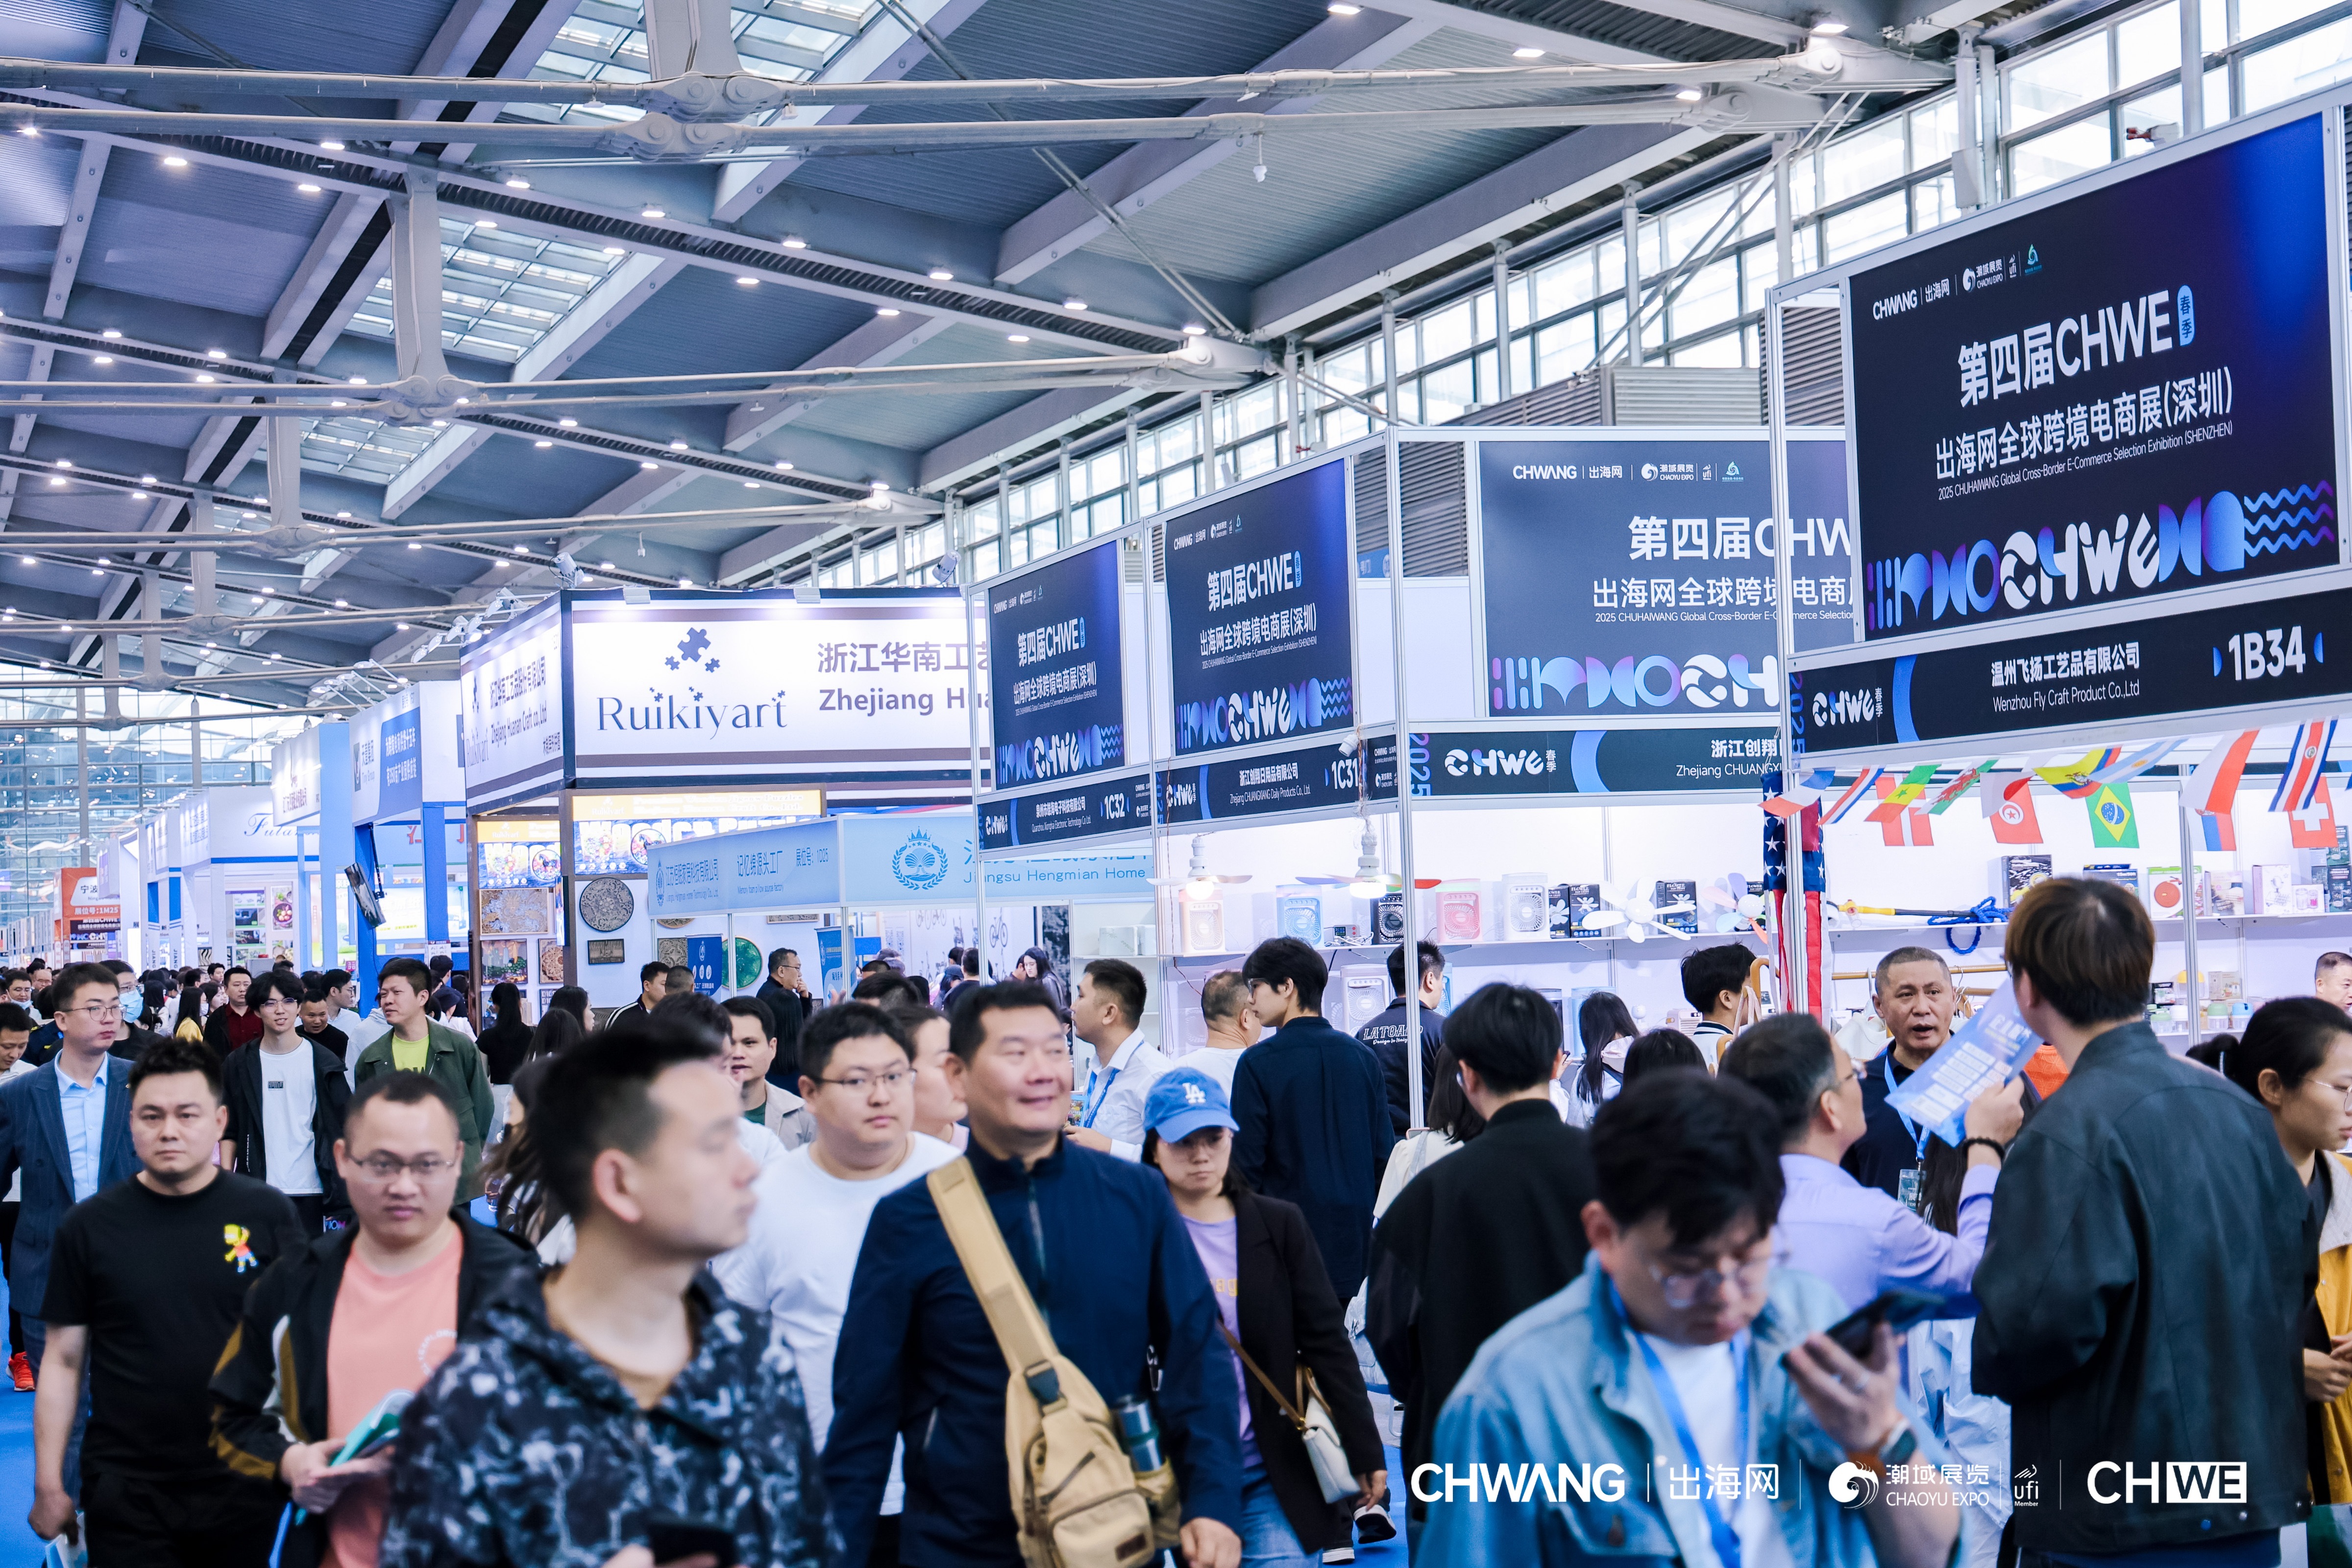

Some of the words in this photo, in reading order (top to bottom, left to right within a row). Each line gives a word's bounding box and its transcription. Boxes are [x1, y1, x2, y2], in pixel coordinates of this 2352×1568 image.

[1976, 259, 2002, 277] 潮域展览
[1977, 276, 1993, 289] CHAOYU
[1993, 273, 2003, 285] EXPO
[1925, 278, 1950, 303] 出海网
[1873, 289, 1917, 320] CHWANG
[2180, 295, 2192, 339] 春季
[1958, 289, 2173, 408] 第四届CHWE
[1936, 366, 2232, 480] 出海网全球跨境电商展(深圳)
[1513, 465, 1577, 480] CHWANG
[1589, 466, 1622, 478] 出海网
[1660, 464, 1693, 473] 潮域展览
[1938, 483, 1954, 500] 2025
[1955, 475, 1999, 497] CHUHAIWANG
[2001, 468, 2021, 486] Global
[2022, 460, 2066, 482] Cross-Border
[2067, 449, 2112, 471] E-Commerce
[2113, 442, 2147, 461] Selection
[2148, 434, 2183, 452] Exhibition
[2184, 420, 2232, 446] (SHENZHEN)
[1174, 533, 1193, 550] CHWANG
[1207, 552, 1294, 612] 第四届CHWE
[1200, 602, 1316, 656] 出海网全球跨境电商展(深圳)
[1595, 613, 1616, 622] 2025
[1618, 612, 1678, 622] CHUHAIWANG
[1680, 612, 1707, 622] Global
[1708, 611, 1763, 621] Cross-Border
[1018, 618, 1079, 667] 第四届CHWE
[1252, 646, 1271, 658] E-Commerce
[1271, 642, 1284, 654] Selection
[2229, 625, 2306, 681] 1B34
[1991, 641, 2139, 687] 温州飞扬工艺品有限公司
[1013, 661, 1097, 705] 出海网全球跨境电商展(深圳)
[1993, 691, 2032, 712] Wenzhou
[2034, 689, 2046, 709] Fly
[2048, 686, 2069, 706] Craft
[2072, 682, 2106, 703] Product
[2108, 678, 2139, 699] Co.,Ltd
[597, 687, 788, 740] Ruikiyart
[819, 687, 933, 716] Zhejiang
[491, 721, 507, 747] Zhejiang
[507, 717, 521, 737] Huanan
[522, 707, 533, 731] Craft
[1545, 749, 1557, 773] 春季
[1711, 738, 1782, 758] 浙江创翔
[1239, 762, 1298, 786] 浙江创翔日用品有限公司
[1331, 758, 1358, 789] 1C31
[1410, 733, 1431, 796] 2025
[1676, 764, 1721, 779] Zhejiang
[1104, 793, 1125, 819] 1C32
[1230, 792, 1244, 806] Zhejiang
[1244, 788, 1270, 803] CHUANGXIANG
[1271, 787, 1279, 801] Daily
[1280, 786, 1296, 798] Products
[1028, 868, 1099, 882] Hengmian
[1105, 866, 1146, 879] Home
[1183, 1082, 1206, 1103] LA
